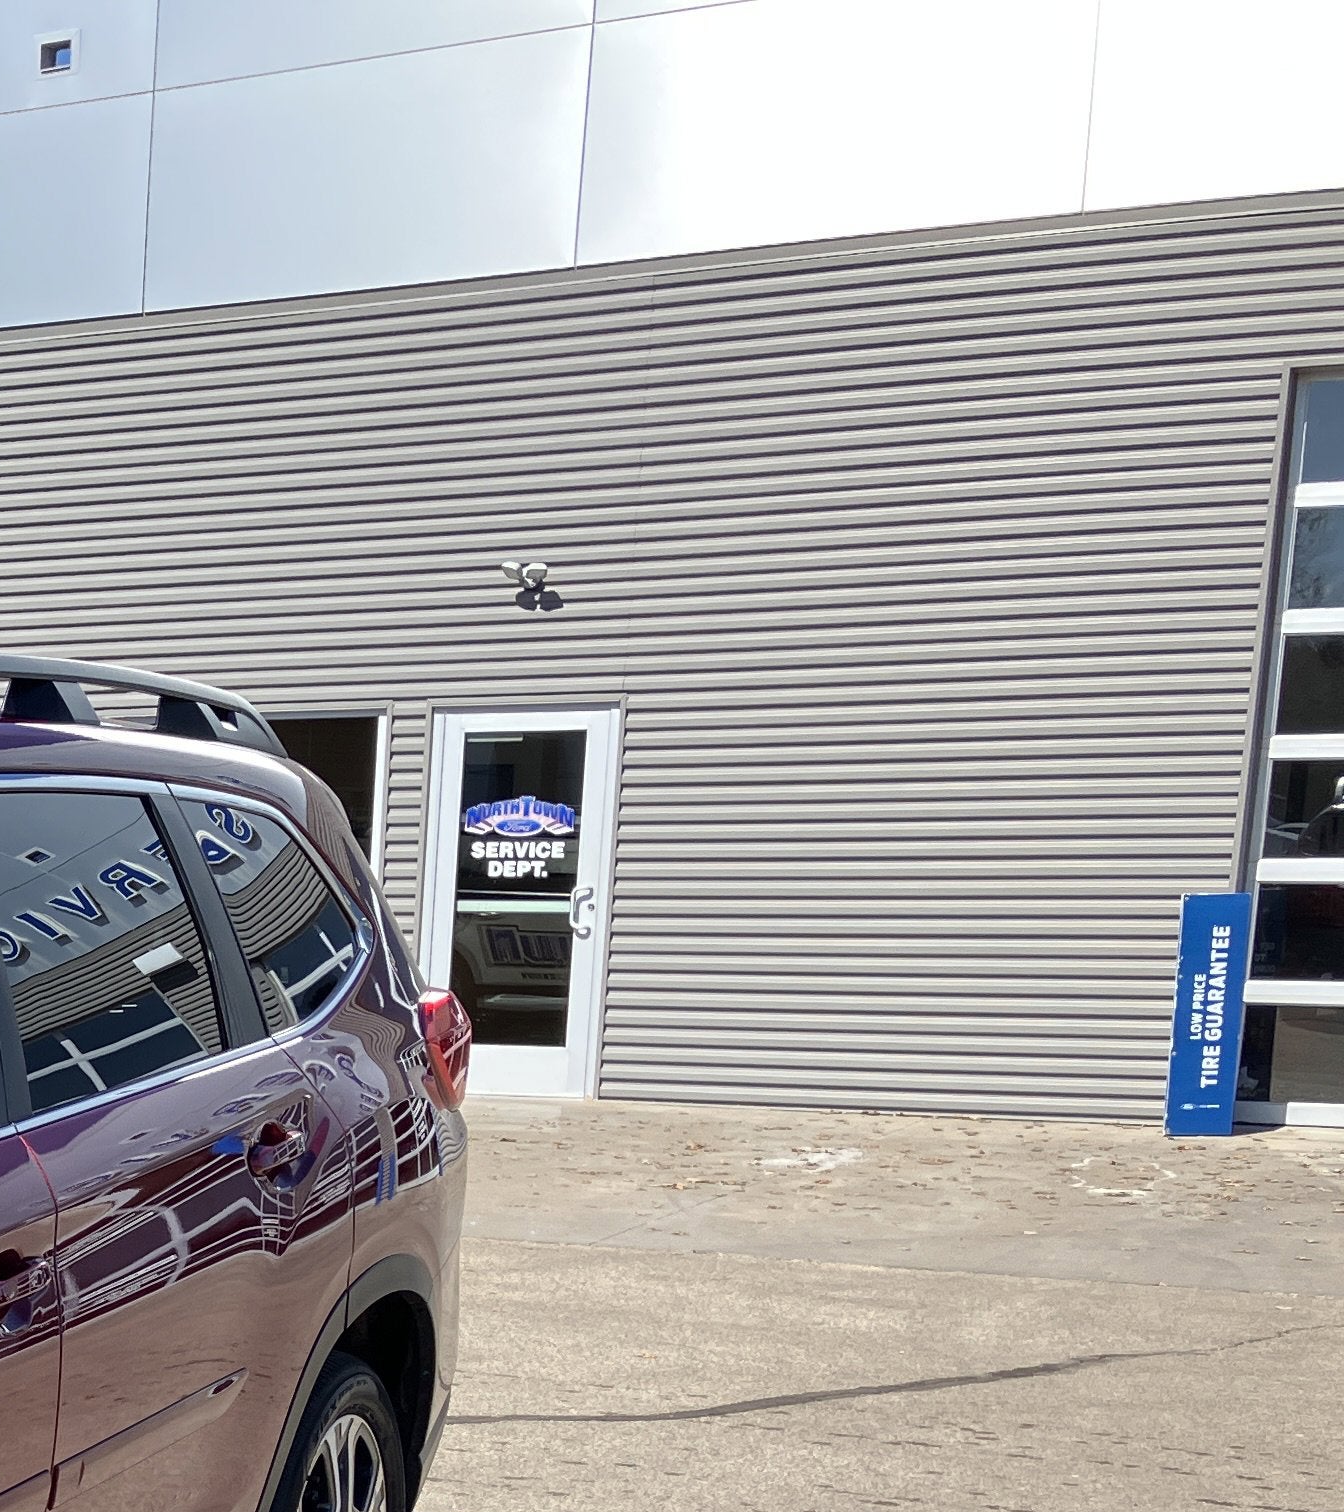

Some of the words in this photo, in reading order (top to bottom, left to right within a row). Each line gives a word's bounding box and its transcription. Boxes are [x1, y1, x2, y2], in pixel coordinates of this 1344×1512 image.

[471, 841, 565, 859] SERVICE
[487, 860, 548, 878] DEPT.
[1193, 973, 1207, 1010] PRICE
[1204, 925, 1231, 1042] GUARANTEE
[1190, 1011, 1203, 1041] LOW
[1200, 1045, 1220, 1089] TIRE
